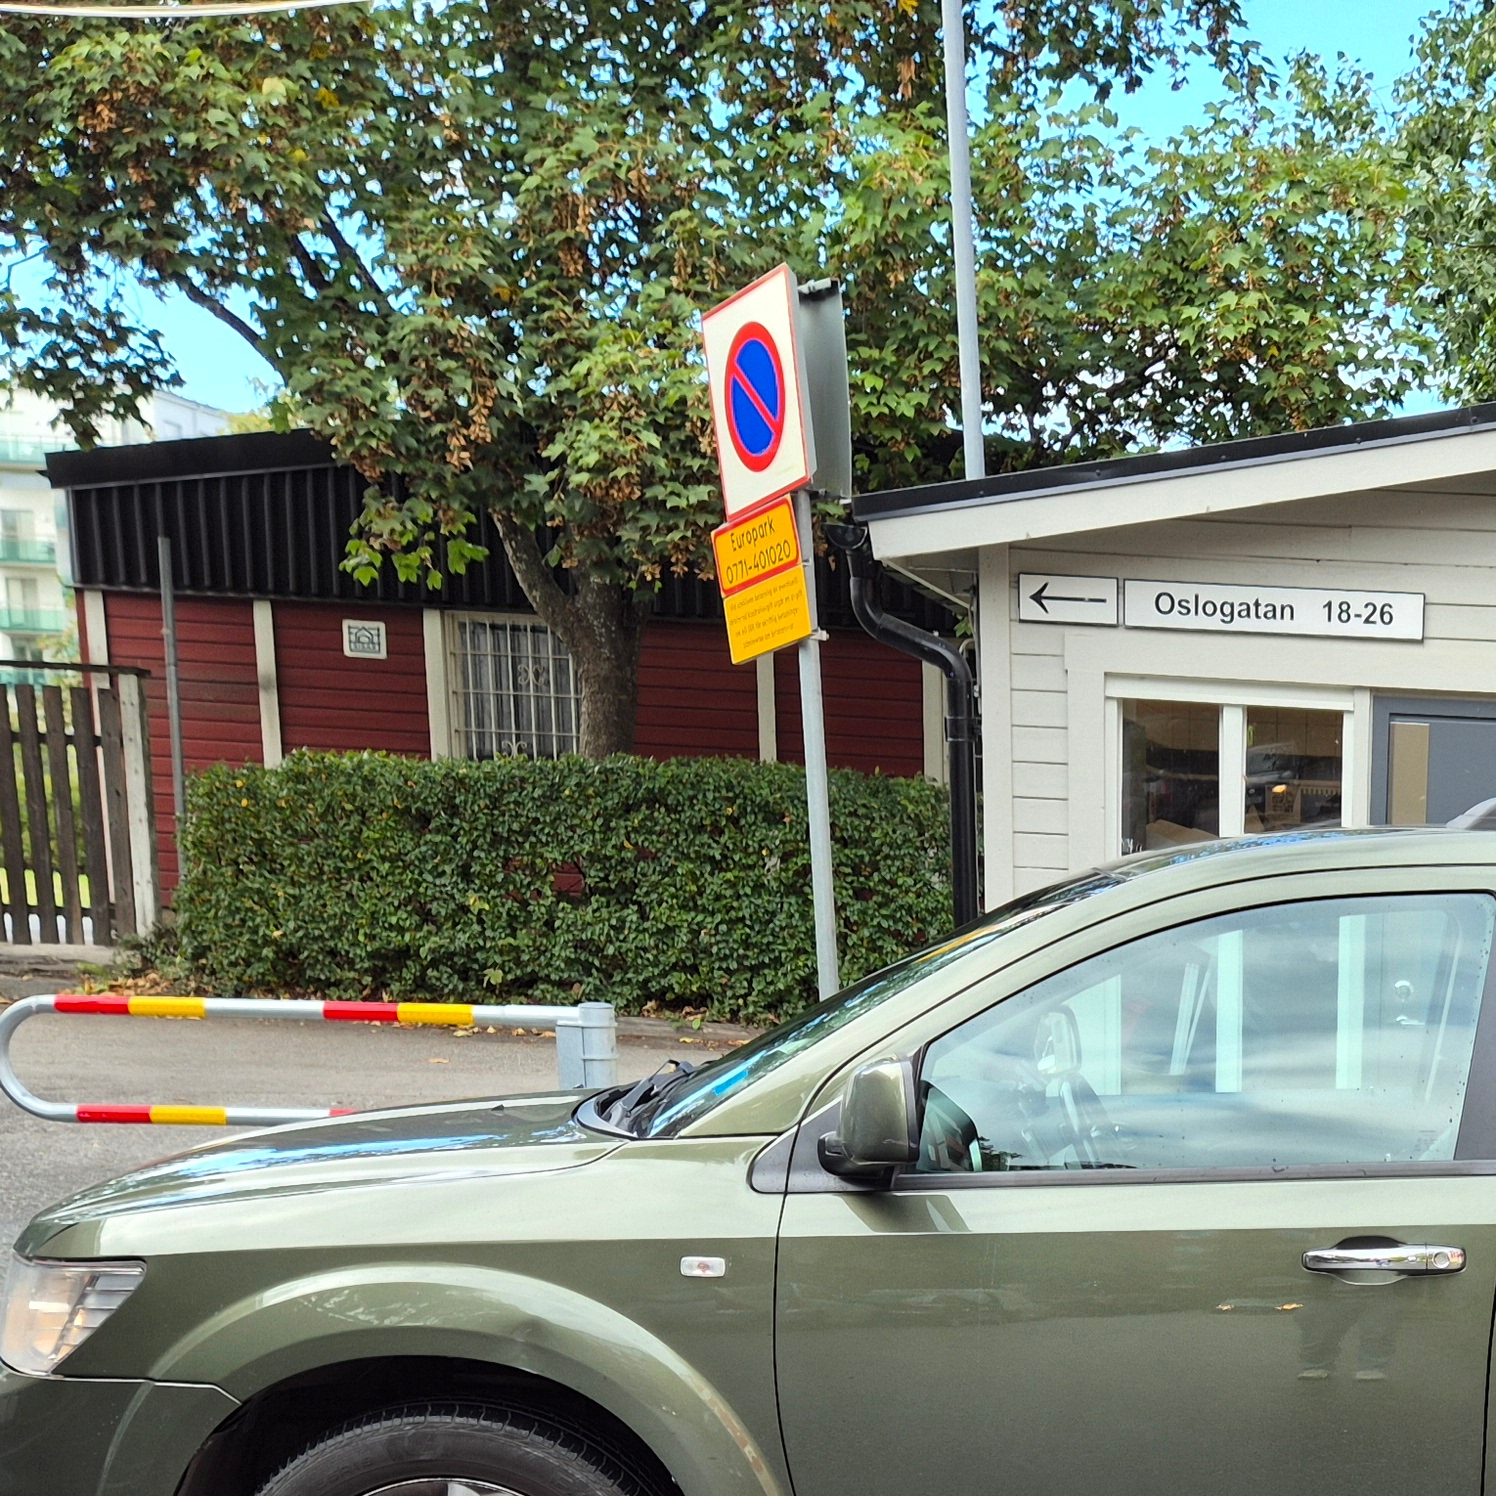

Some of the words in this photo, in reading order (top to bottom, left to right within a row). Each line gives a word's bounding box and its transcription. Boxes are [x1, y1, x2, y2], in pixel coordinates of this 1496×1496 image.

[730, 515, 775, 552] Europark
[726, 539, 791, 584] 0771-401020
[1154, 592, 1295, 624] Oslogatan
[1322, 600, 1394, 625] 18-26
